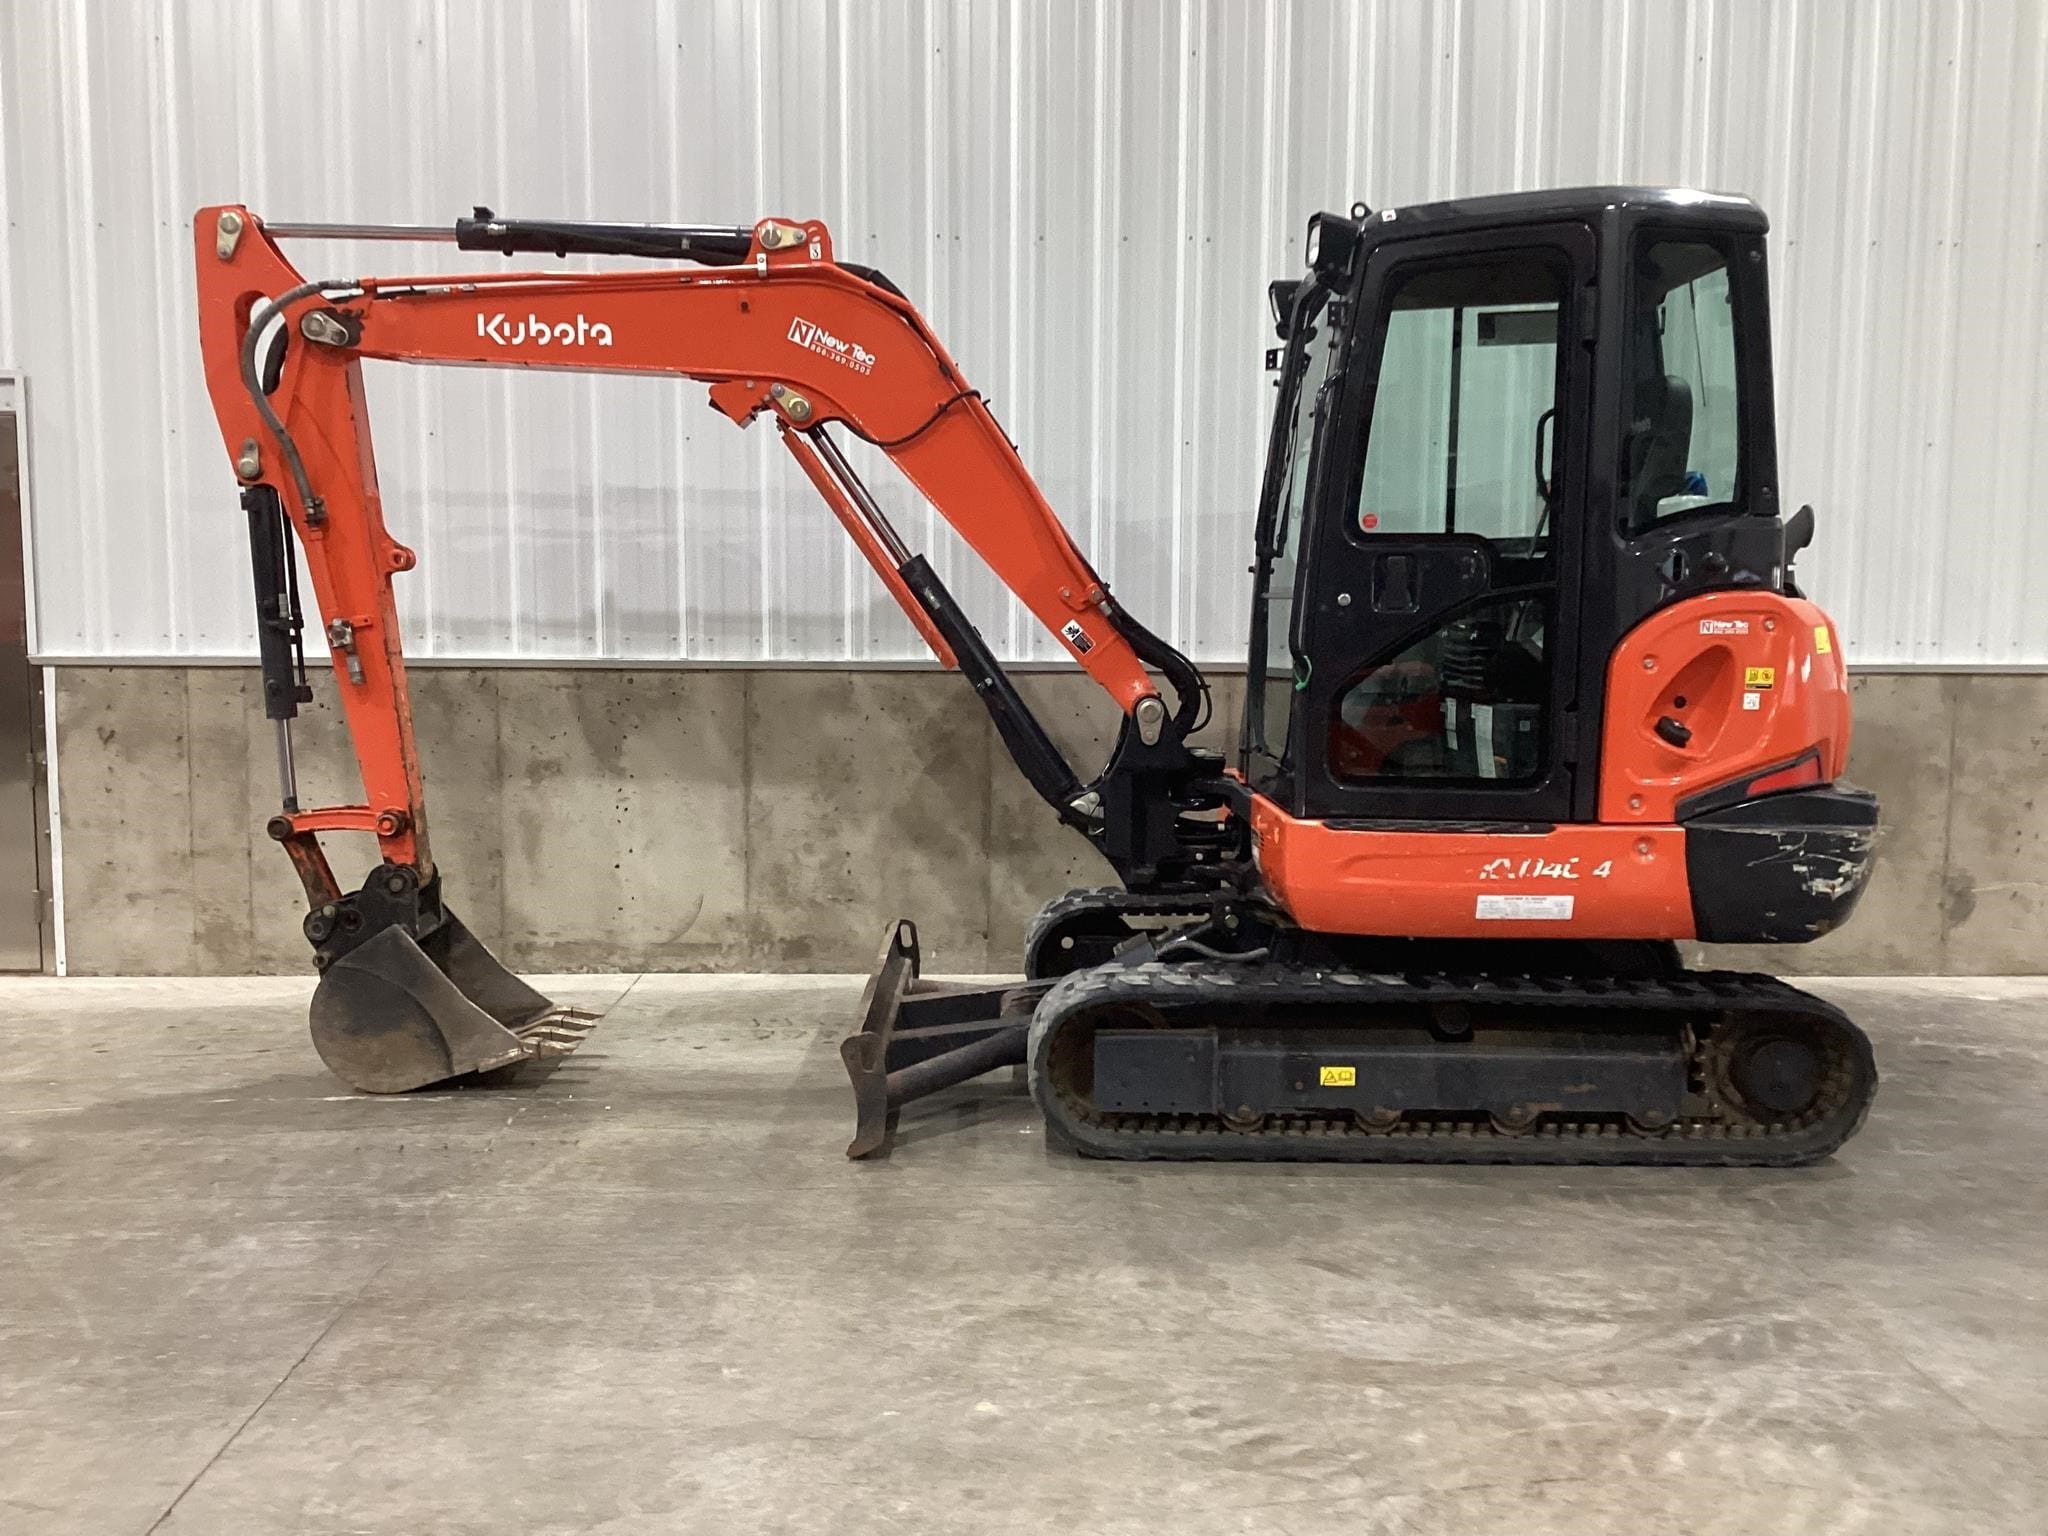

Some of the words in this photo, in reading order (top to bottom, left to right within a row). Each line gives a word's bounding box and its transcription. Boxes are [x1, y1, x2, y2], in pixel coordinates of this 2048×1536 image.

[477, 313, 613, 346] Kubota
[814, 328, 850, 353] New
[852, 343, 876, 365] Tec
